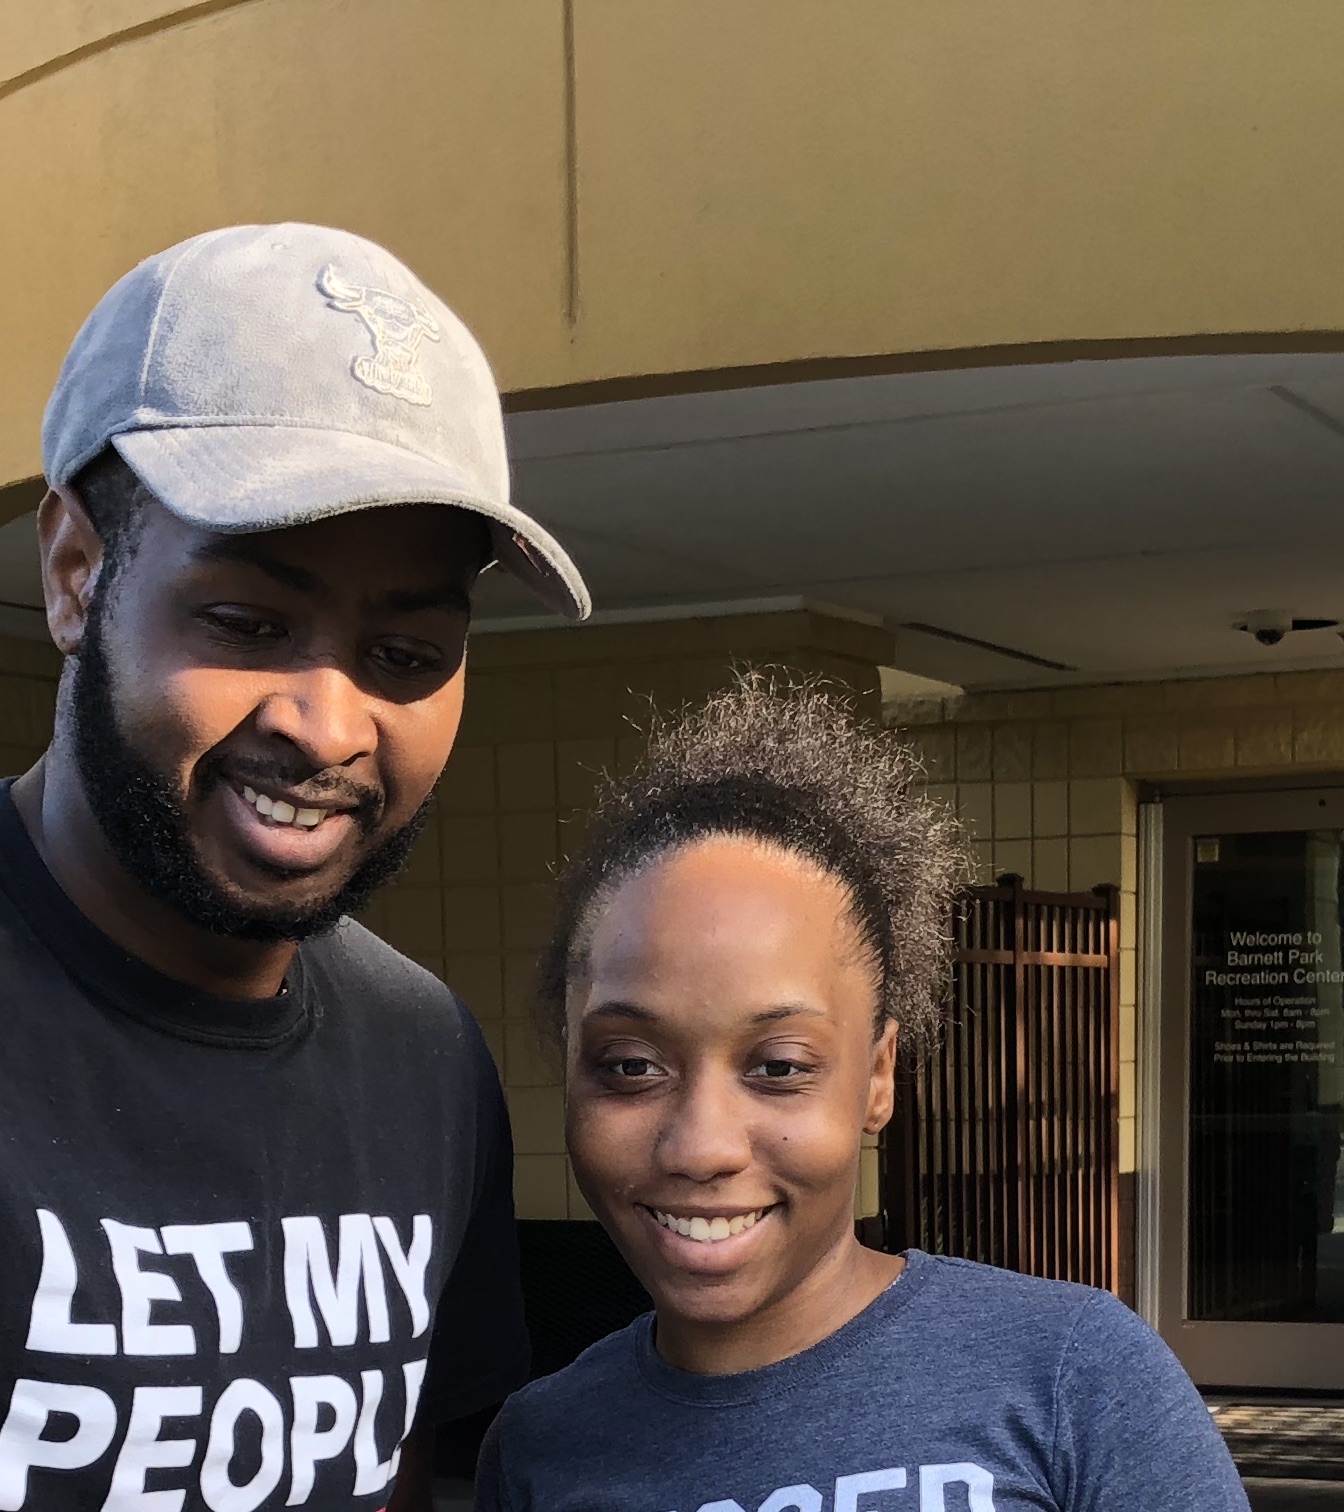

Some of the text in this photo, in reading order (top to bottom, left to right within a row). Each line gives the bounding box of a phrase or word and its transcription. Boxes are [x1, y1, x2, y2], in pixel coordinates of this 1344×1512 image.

[1229, 931, 1322, 946] Welcome to
[1227, 949, 1324, 966] Barnett Park
[1205, 970, 1288, 985] Recreation
[25, 1208, 432, 1356] LET MY
